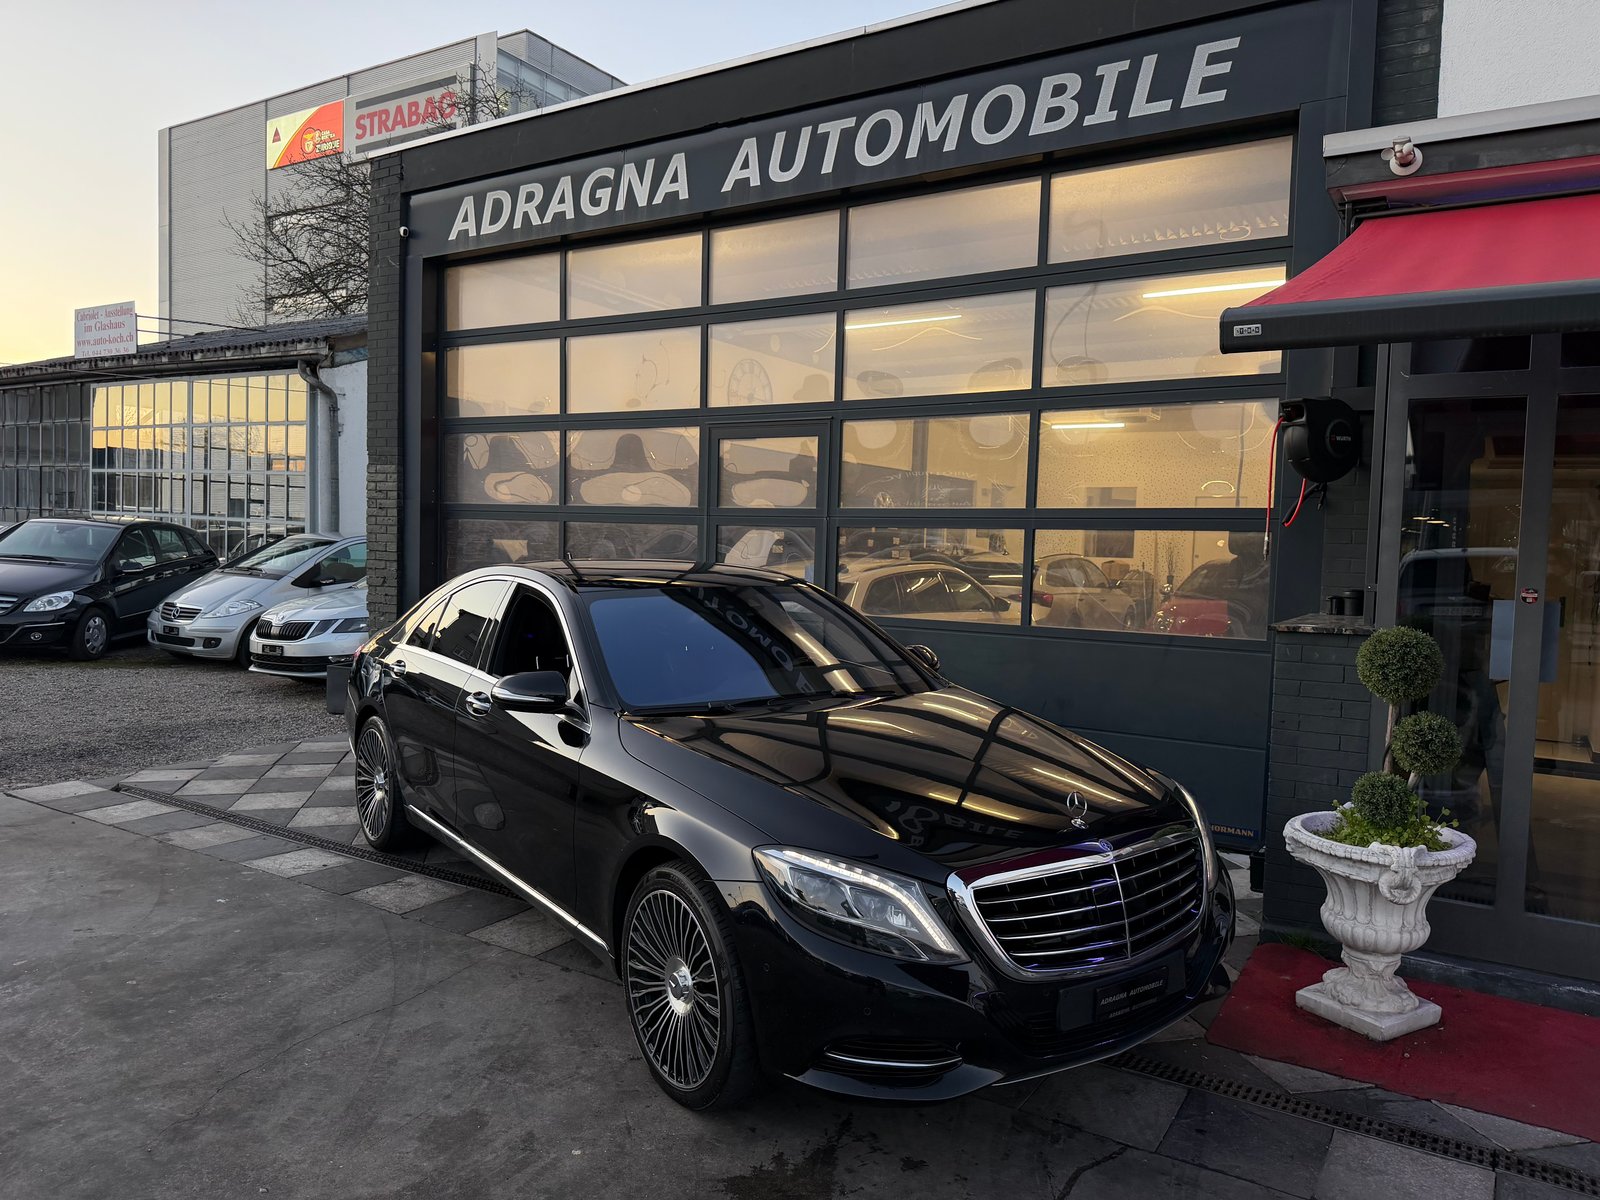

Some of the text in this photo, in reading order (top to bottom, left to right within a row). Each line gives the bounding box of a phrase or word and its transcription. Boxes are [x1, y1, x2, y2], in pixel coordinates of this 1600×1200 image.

[448, 36, 1241, 240] ADRAGNA AUTOMOBILE
[84, 320, 126, 333] im Glashaus
[77, 332, 134, 346] www.auto-koch.ch
